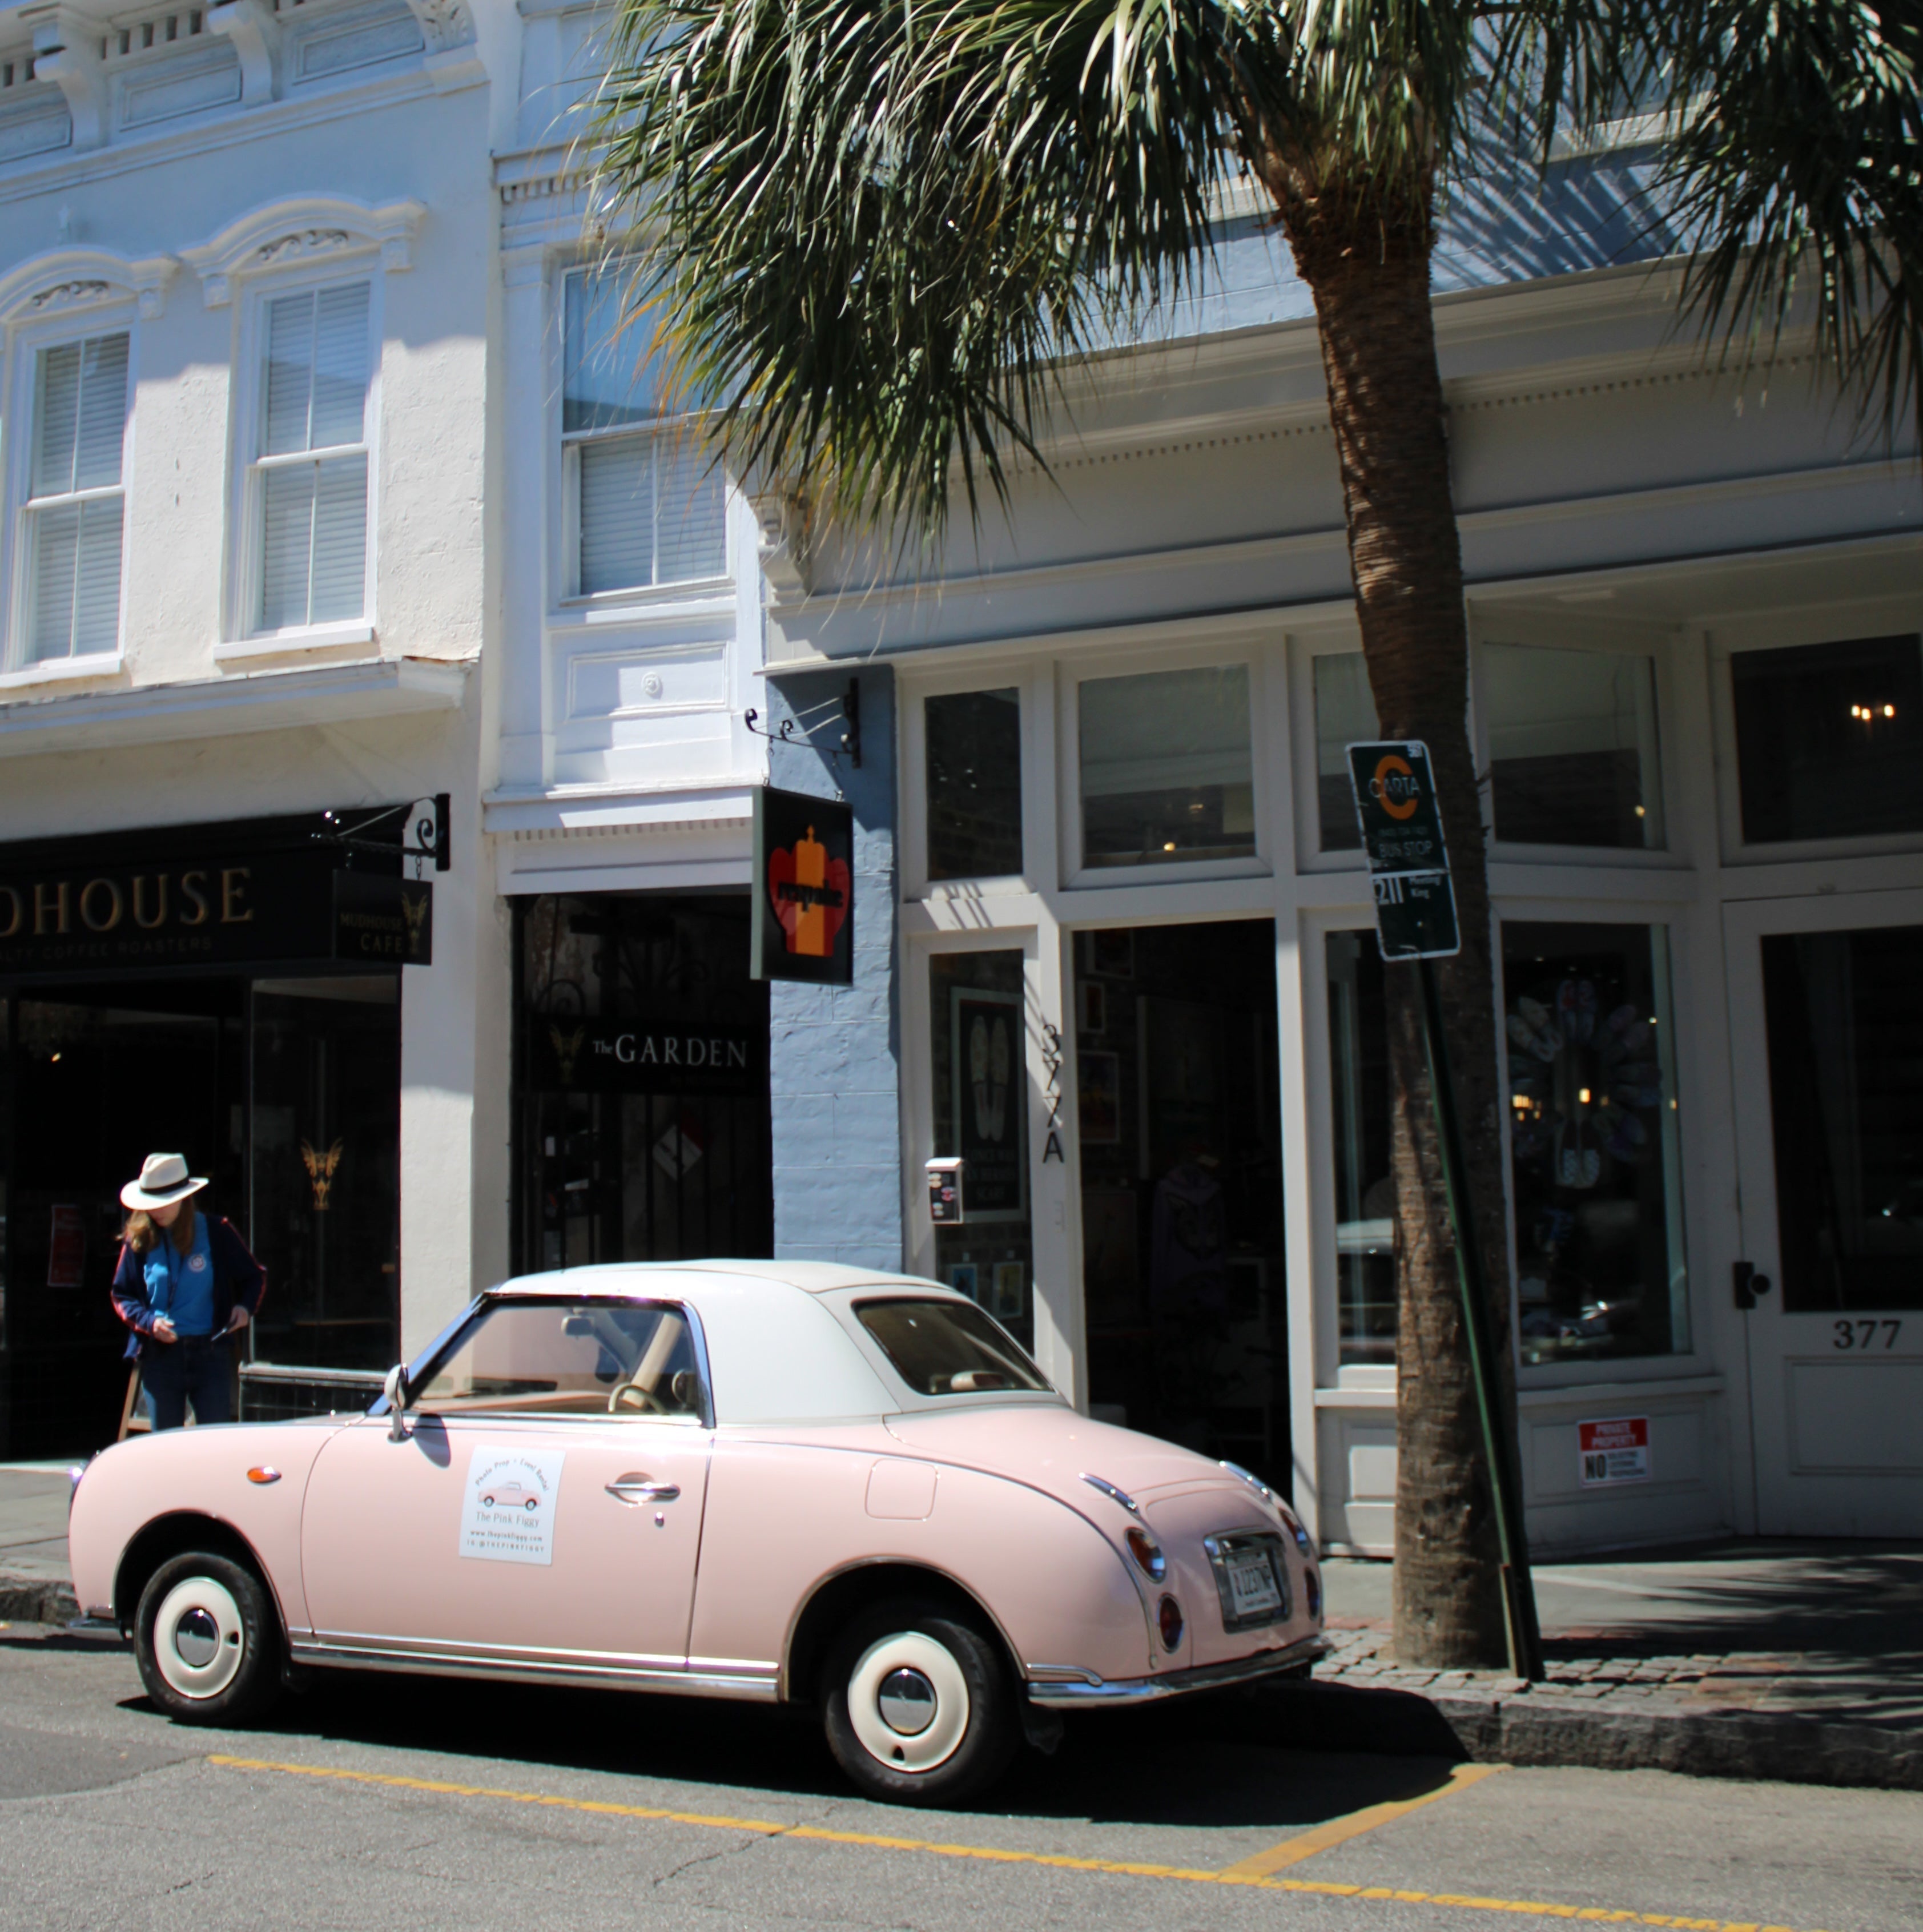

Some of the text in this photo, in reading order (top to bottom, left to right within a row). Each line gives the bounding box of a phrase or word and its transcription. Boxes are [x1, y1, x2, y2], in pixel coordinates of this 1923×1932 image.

[1369, 777, 1422, 799] CARTA
[1378, 840, 1434, 859] BUS STOP
[339, 912, 403, 931] MUDHOUSE
[42, 941, 109, 960] COFFEE
[118, 936, 212, 956] ROASTERS
[592, 1034, 748, 1069] The GARDEN
[1043, 1024, 1064, 1164] 377A
[1833, 1319, 1902, 1350] 377
[1592, 1434, 1637, 1449] PROPERTY
[494, 1459, 510, 1470] Prop
[1585, 1454, 1606, 1480] NO
[477, 1511, 540, 1528] The Pink Figgy
